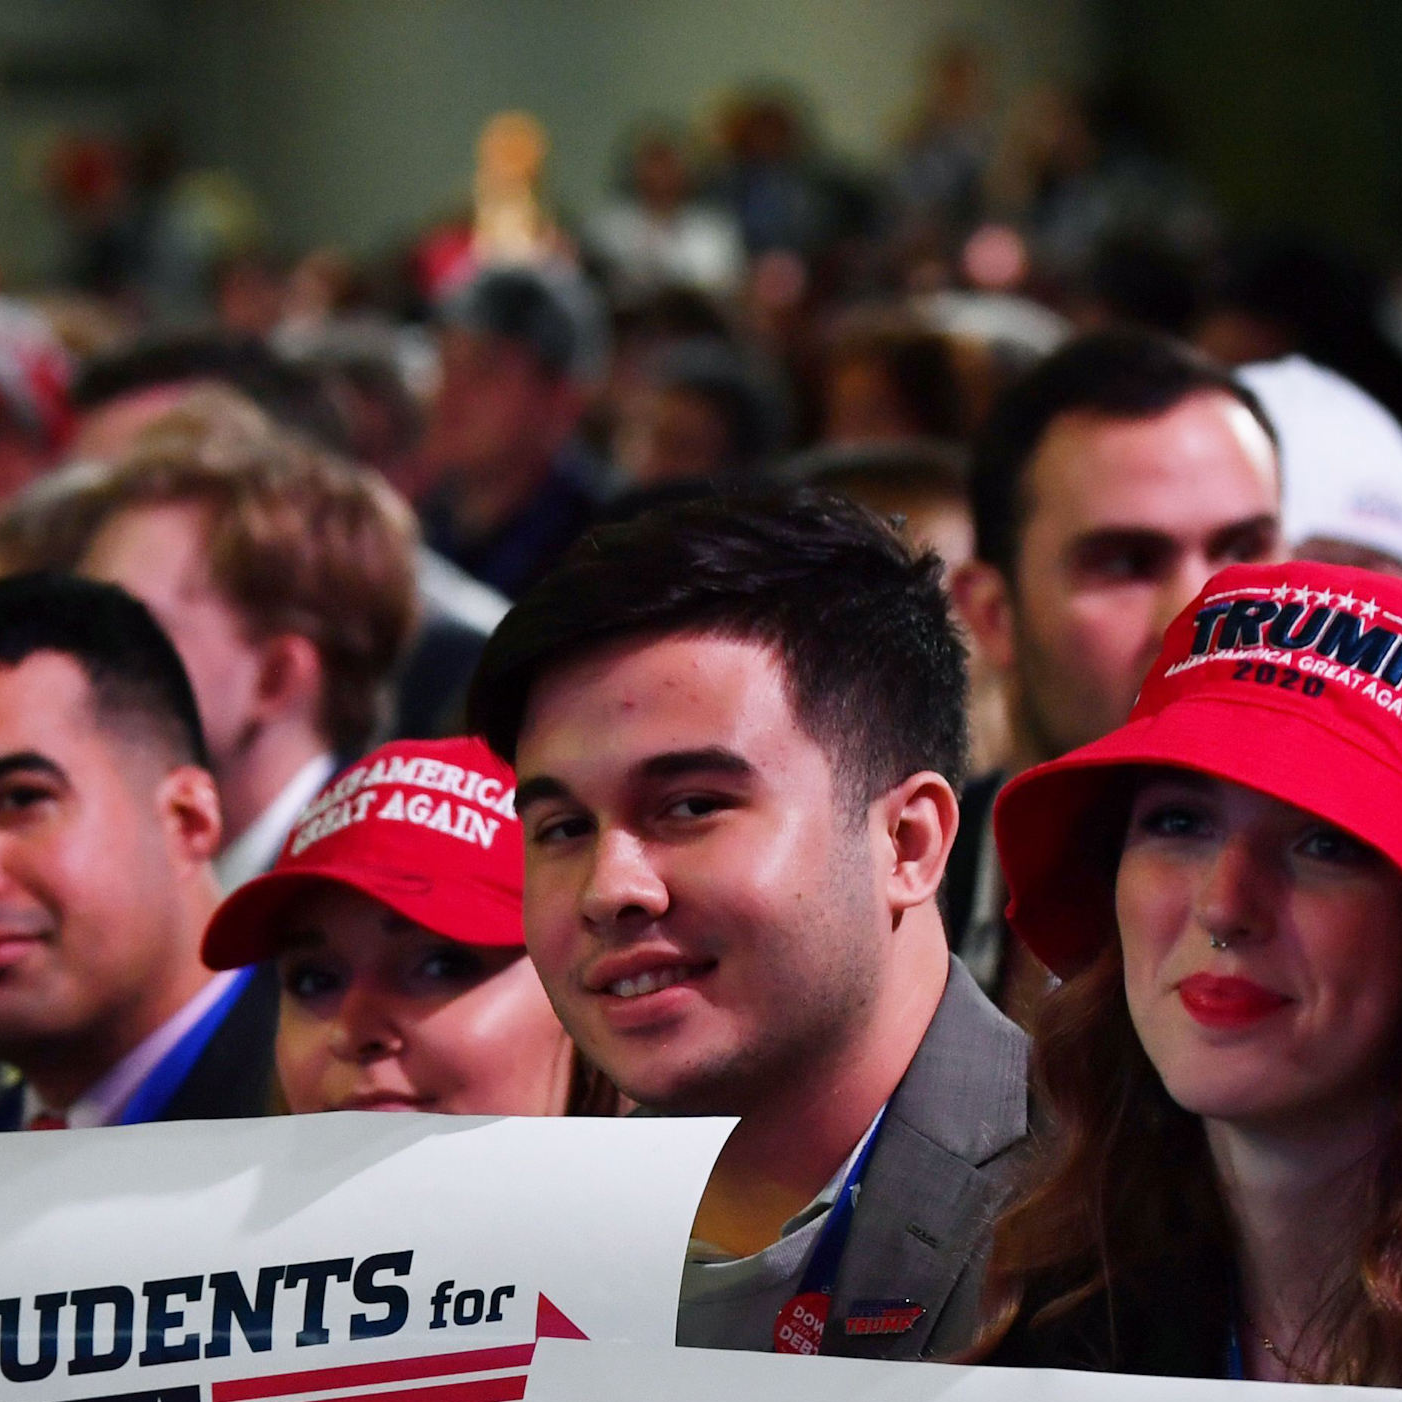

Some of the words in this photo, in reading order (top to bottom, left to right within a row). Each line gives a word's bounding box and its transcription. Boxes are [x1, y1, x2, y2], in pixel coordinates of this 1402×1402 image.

[1232, 659, 1326, 698] 2020
[1297, 654, 1366, 690] GREAT
[363, 755, 518, 821] AMERICA
[376, 789, 501, 850] AGAIN
[428, 1279, 515, 1331] for
